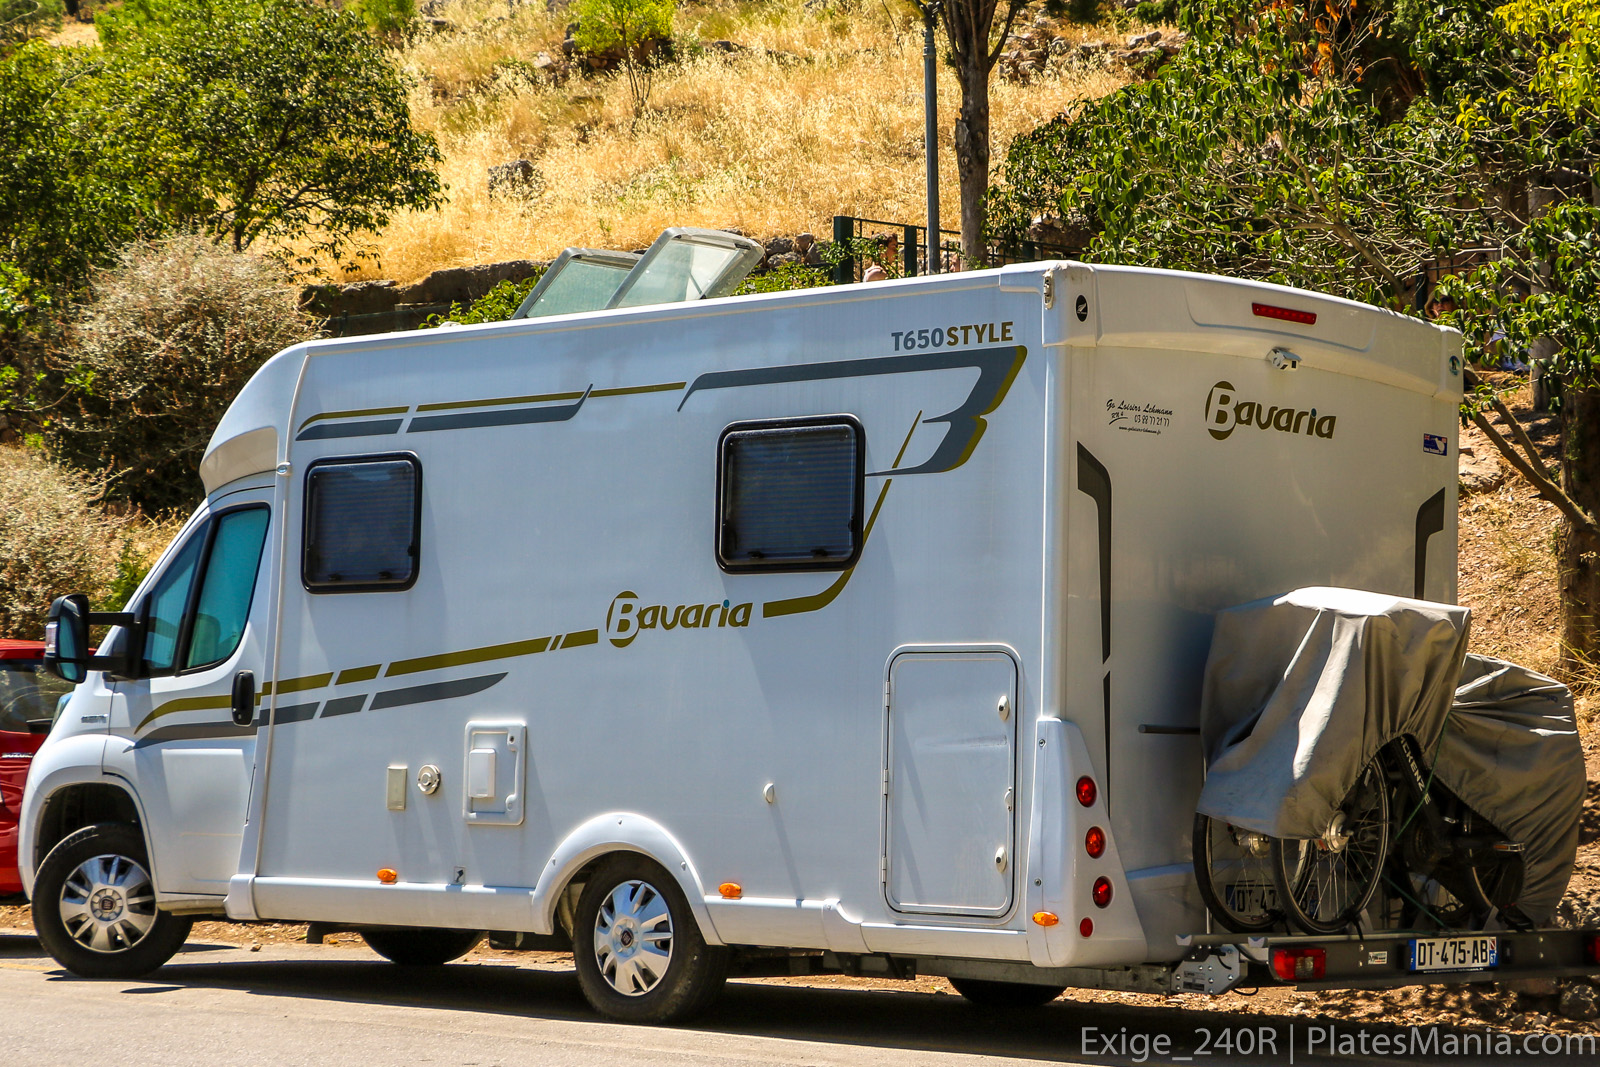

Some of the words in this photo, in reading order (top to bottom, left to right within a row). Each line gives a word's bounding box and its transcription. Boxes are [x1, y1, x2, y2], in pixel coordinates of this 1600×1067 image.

[1117, 400, 1141, 412] Loisirs
[1142, 403, 1173, 416] Lehmann
[1134, 414, 1141, 424] 03
[1205, 380, 1337, 441] Bavaria
[606, 590, 753, 649] Bavaria
[1417, 939, 1489, 967] DT-475-AB
